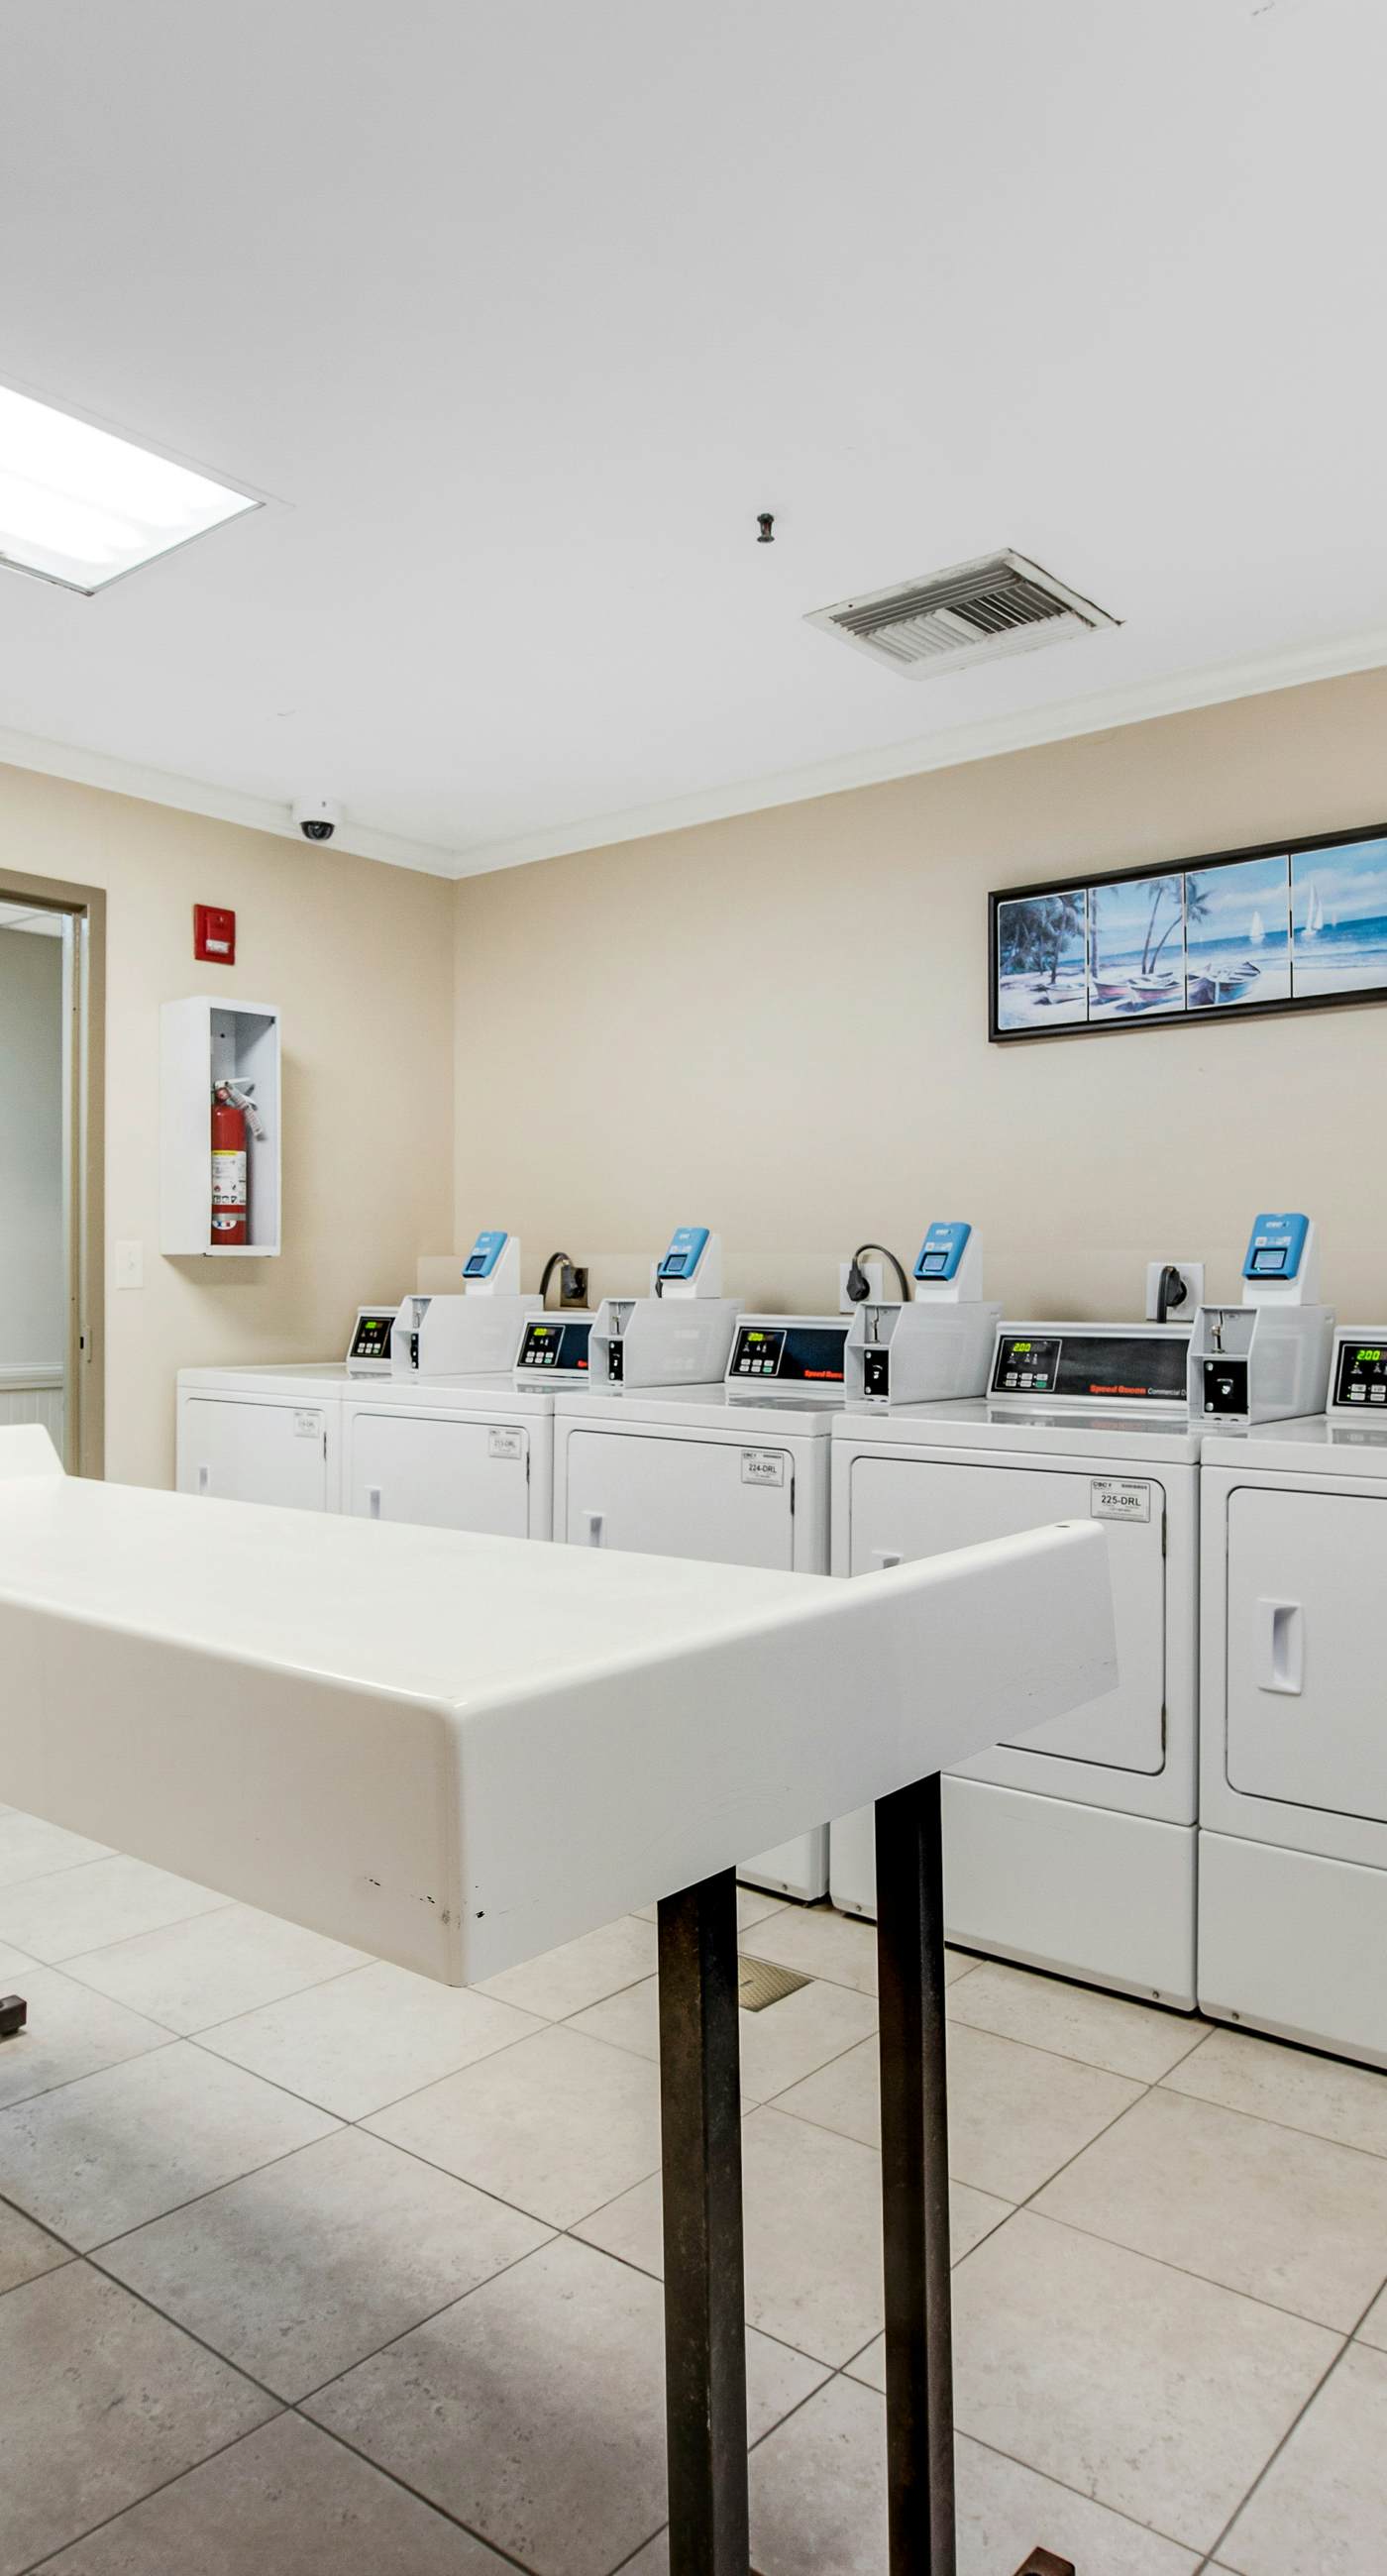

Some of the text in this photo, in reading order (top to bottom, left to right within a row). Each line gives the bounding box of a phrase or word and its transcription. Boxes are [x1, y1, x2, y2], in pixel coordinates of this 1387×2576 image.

[1090, 1384, 1118, 1394] Speed
[1118, 1385, 1147, 1395] Queen
[1101, 1494, 1141, 1507] 225-DRL
